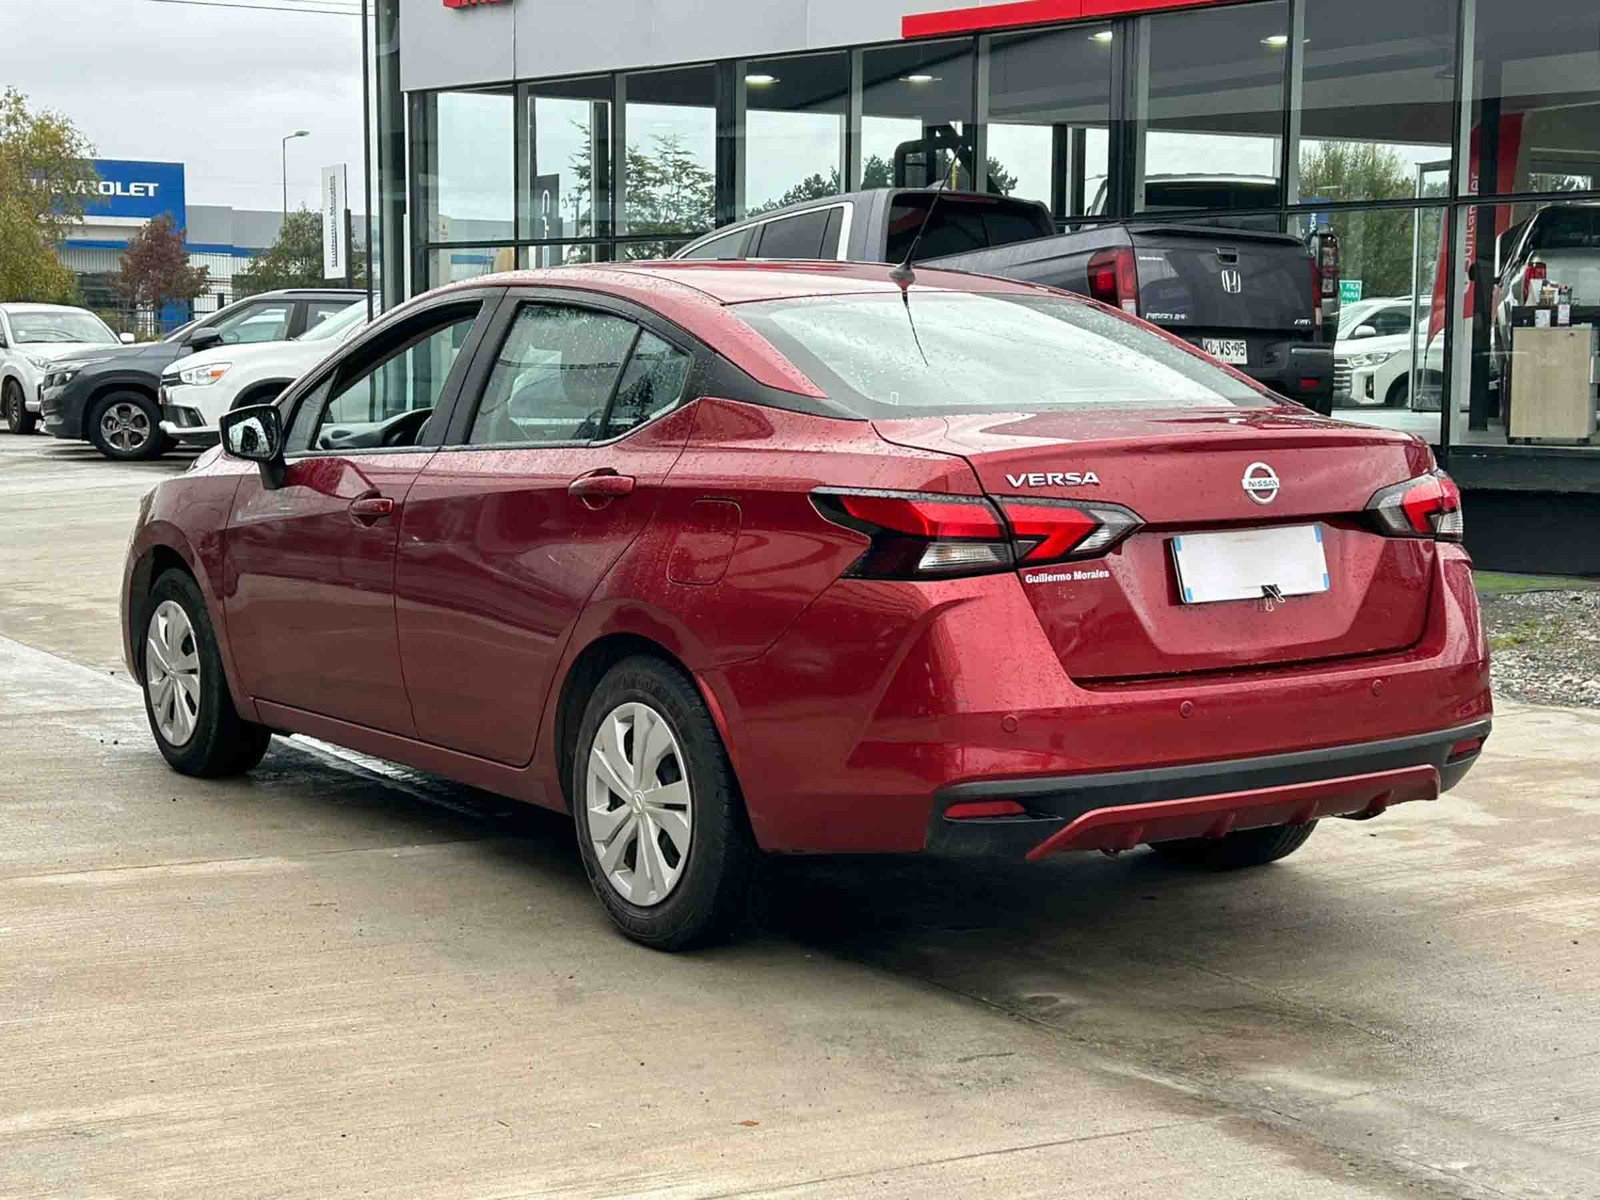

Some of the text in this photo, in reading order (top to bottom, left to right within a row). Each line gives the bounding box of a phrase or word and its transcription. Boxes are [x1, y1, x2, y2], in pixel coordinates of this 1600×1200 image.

[1005, 471, 1100, 488] VERSA
[1247, 479, 1278, 488] NISSAN
[1025, 569, 1110, 583] Guillermo Morales
